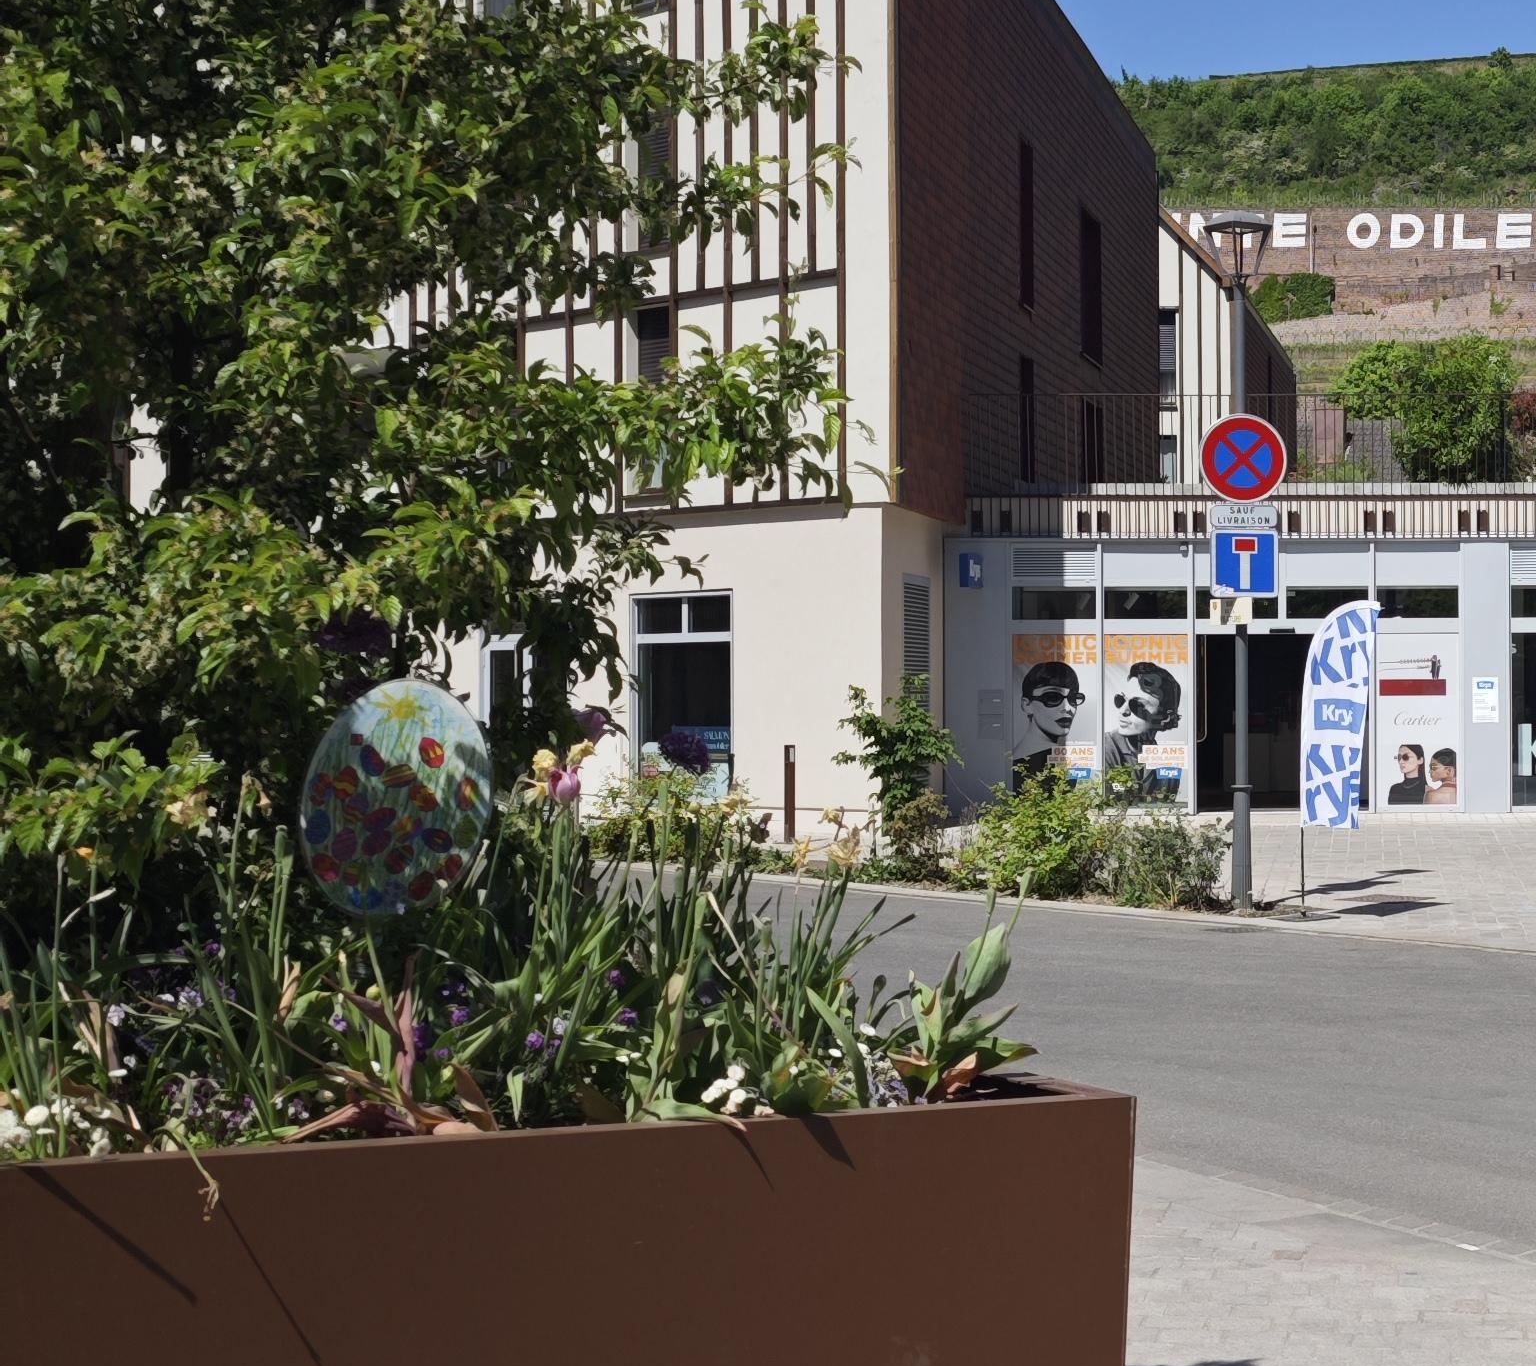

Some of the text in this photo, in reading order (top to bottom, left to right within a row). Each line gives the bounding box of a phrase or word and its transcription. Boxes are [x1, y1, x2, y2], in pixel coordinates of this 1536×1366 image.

[1346, 212, 1533, 249] ODILE
[1230, 507, 1255, 515] SAUF
[1217, 517, 1270, 525] LIVRAISON
[1104, 635, 1188, 650] ICONIC
[1105, 651, 1188, 664] SUMMER
[1393, 710, 1442, 727] Cartier
[1071, 747, 1094, 755] ANS
[1161, 747, 1185, 755] ANS
